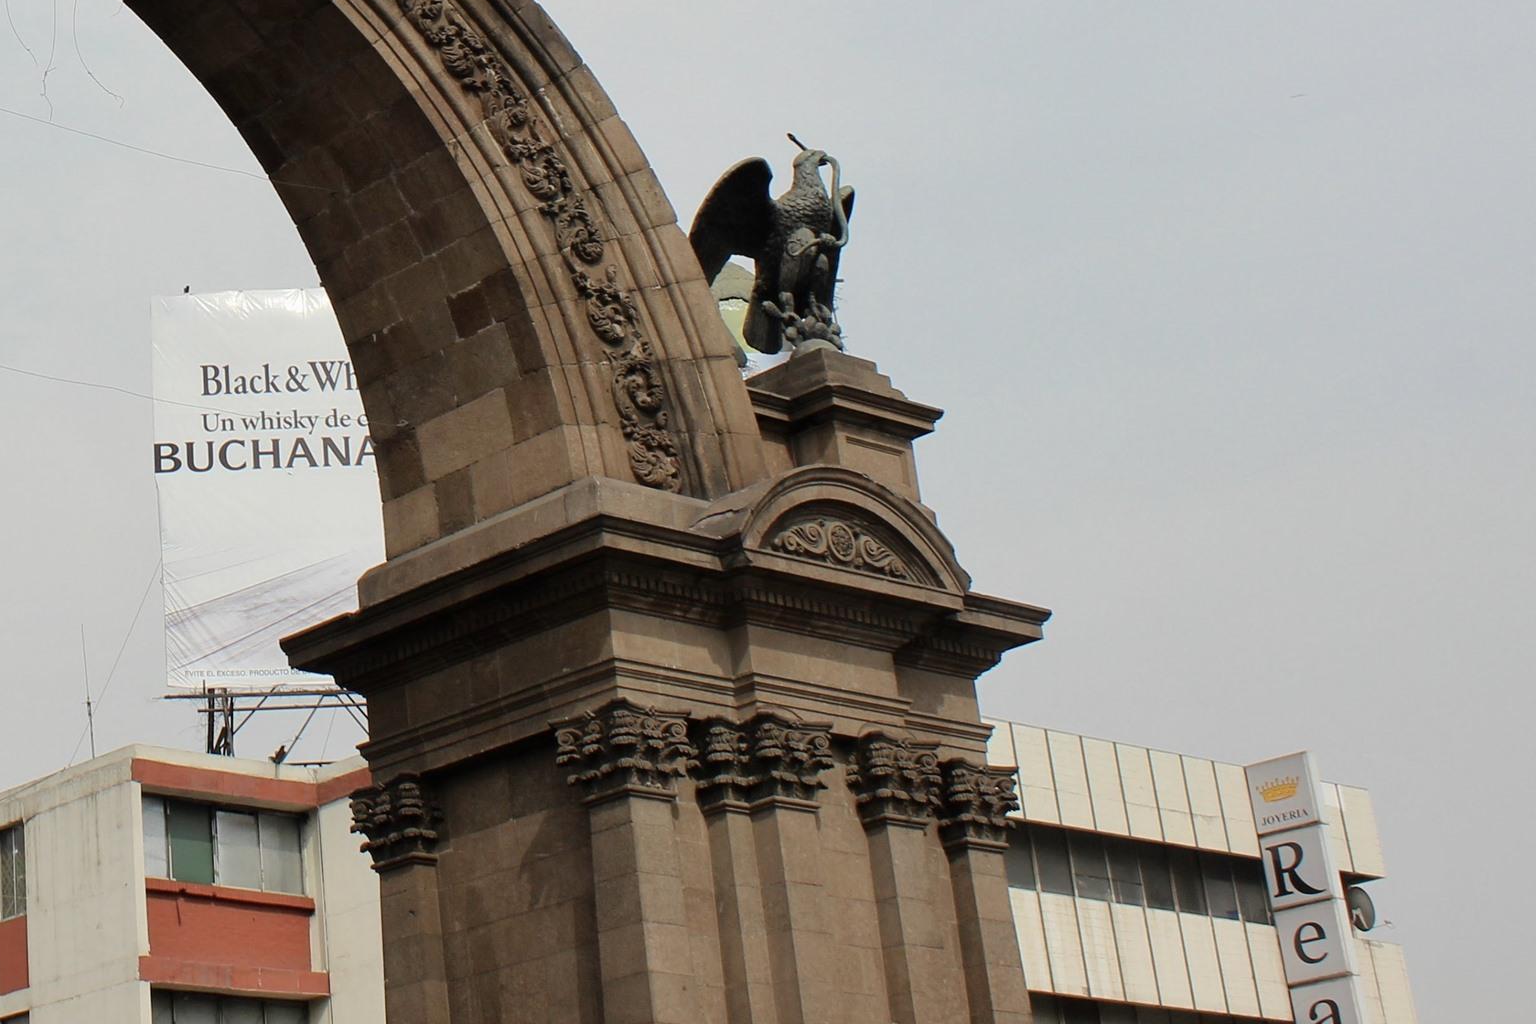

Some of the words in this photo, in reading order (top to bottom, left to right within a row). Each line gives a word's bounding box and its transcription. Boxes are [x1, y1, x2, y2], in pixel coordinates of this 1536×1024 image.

[201, 413, 235, 432] Un
[241, 408, 318, 435] whisky
[325, 408, 351, 427] de
[154, 435, 375, 473] BUCHANA
[249, 669, 289, 677] PRODUCTO
[1261, 808, 1309, 826] JOYERIA
